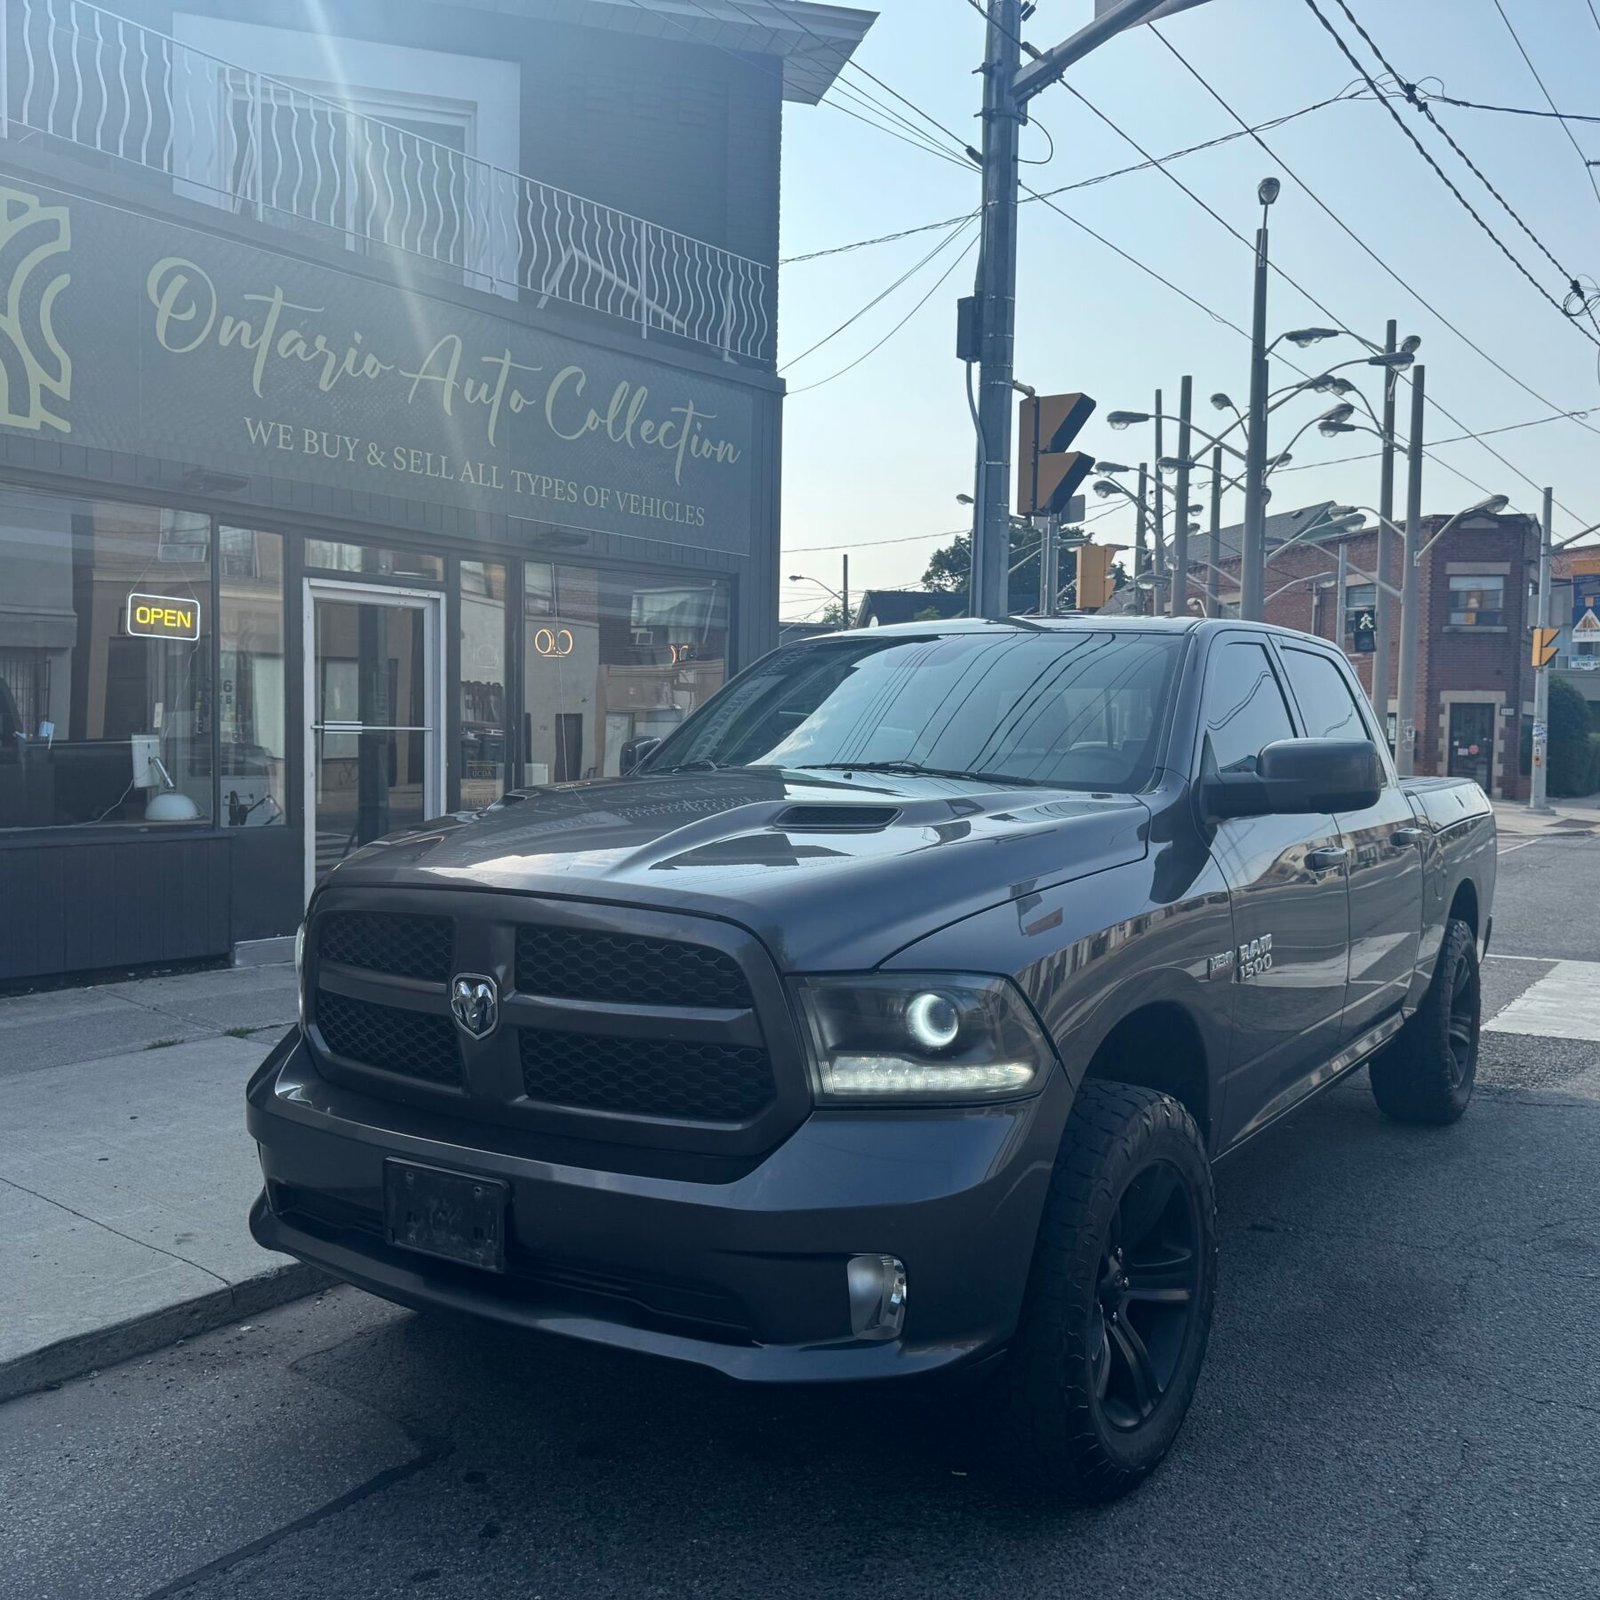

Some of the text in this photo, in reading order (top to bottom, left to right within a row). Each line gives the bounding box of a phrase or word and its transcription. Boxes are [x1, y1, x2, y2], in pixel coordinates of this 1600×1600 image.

[147, 257, 742, 486] Ontario Auto Collection
[243, 416, 705, 527] WE BUY & SELL ALL TYPES OF VEHICLES
[136, 606, 191, 628] OPEN
[1239, 933, 1272, 961] RAM
[1240, 953, 1272, 979] 1500
